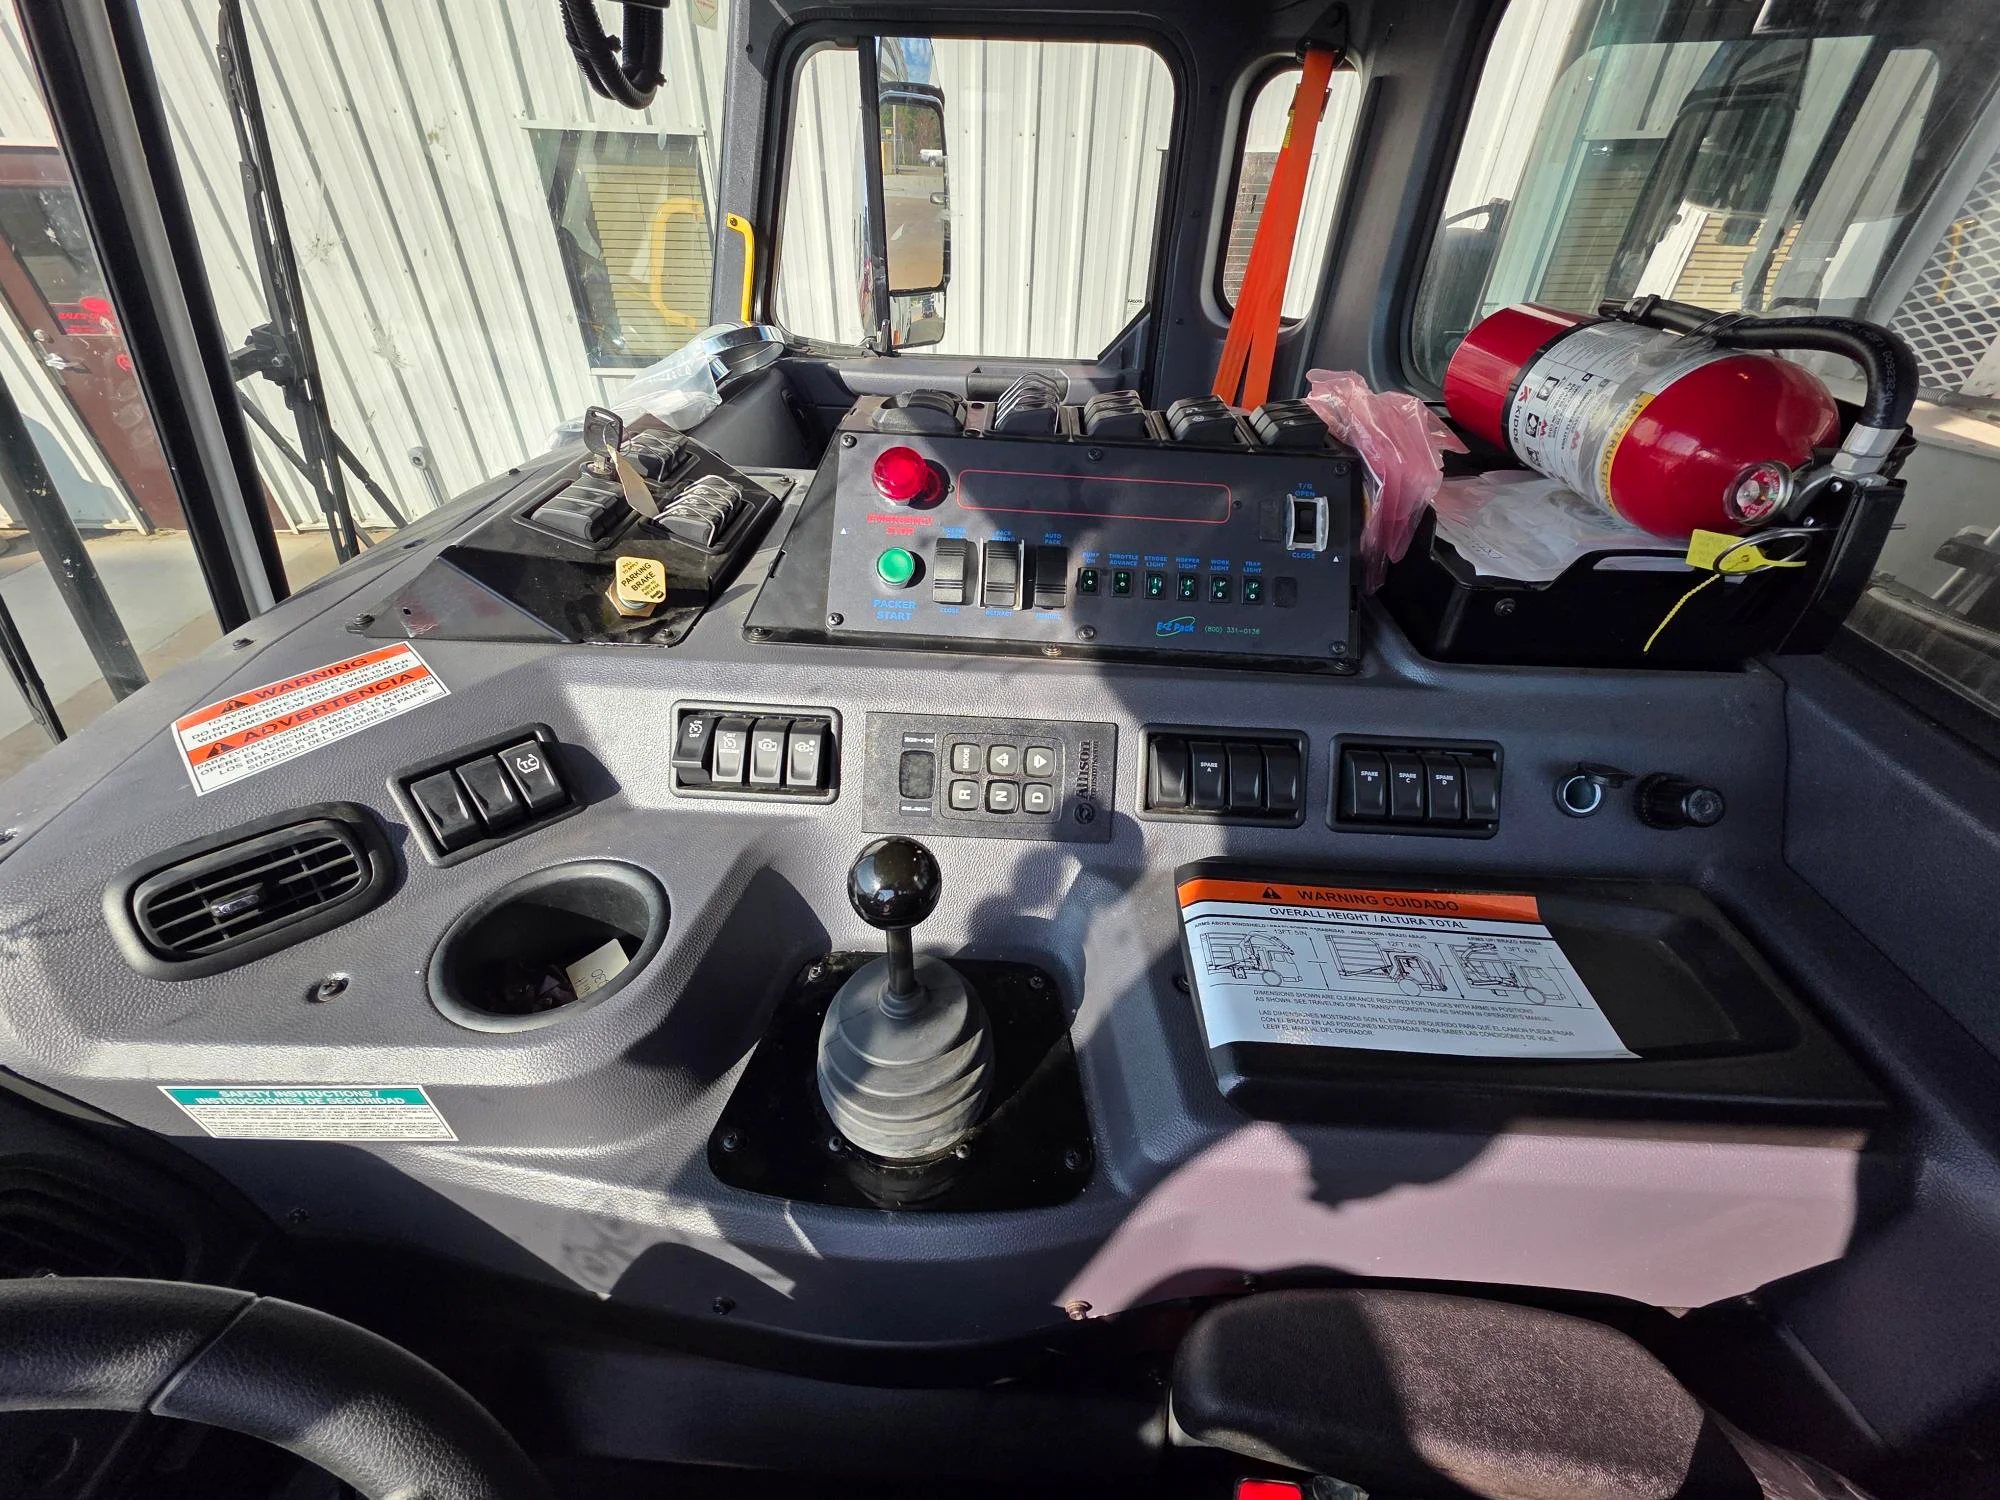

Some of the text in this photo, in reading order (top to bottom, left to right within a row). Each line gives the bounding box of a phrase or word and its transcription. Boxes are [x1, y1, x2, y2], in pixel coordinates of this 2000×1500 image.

[1513, 405, 1522, 444] KIDDE
[886, 527, 915, 535] STOP
[621, 562, 652, 586] PARKING
[631, 571, 656, 591] BRAKE
[872, 600, 917, 609] PACKER
[876, 611, 912, 621] START
[1174, 622, 1195, 632] Pack
[1204, 625, 1223, 633] (800)
[253, 658, 368, 699] WARNING
[197, 663, 409, 743] WITH ARMS BELOW TOP OF WINDSHIELD
[207, 718, 221, 726] TO
[223, 706, 256, 720] AVOID
[258, 689, 303, 708] SERIOUS
[304, 677, 339, 692] INJURY
[357, 659, 389, 673] DEATH
[191, 729, 209, 739] DO
[211, 720, 235, 732] NOT
[238, 700, 290, 722] OPERATE
[292, 684, 337, 703] VEHICLE
[339, 673, 368, 686] OVER
[241, 671, 414, 742] ADVERTENCIA
[196, 756, 226, 770] PARA
[228, 741, 264, 758] EVITAR
[266, 721, 315, 743] LESIONES
[316, 706, 355, 723] GRAVES
[366, 696, 380, 704] LA
[381, 681, 417, 697] MUERTE
[199, 756, 241, 775] OPERE
[243, 749, 259, 758] EL
[353, 706, 368, 715] DE
[412, 680, 434, 691] CON
[218, 762, 243, 775] LOS
[246, 742, 293, 764] BRAZOS
[295, 732, 318, 744] POR
[320, 714, 364, 734] DEBAJO
[365, 707, 380, 716] DE
[381, 701, 396, 709] LA
[396, 688, 429, 703] PARTE
[247, 707, 398, 770] SUPERIOR DEL PARABRISAS
[522, 758, 536, 769] TC
[1076, 740, 1091, 800] Allison
[959, 789, 971, 800] R
[996, 791, 1008, 801] N
[1032, 792, 1044, 803] D
[1296, 890, 1461, 911] WARNING CUIDADO
[1268, 907, 1468, 928] OVERALL HEIGHT ALTURA TOTAL
[1308, 999, 1344, 1007] TRAVELING
[1335, 1021, 1377, 1029] POSICIONES
[1478, 1031, 1526, 1039] CONDICIONES
